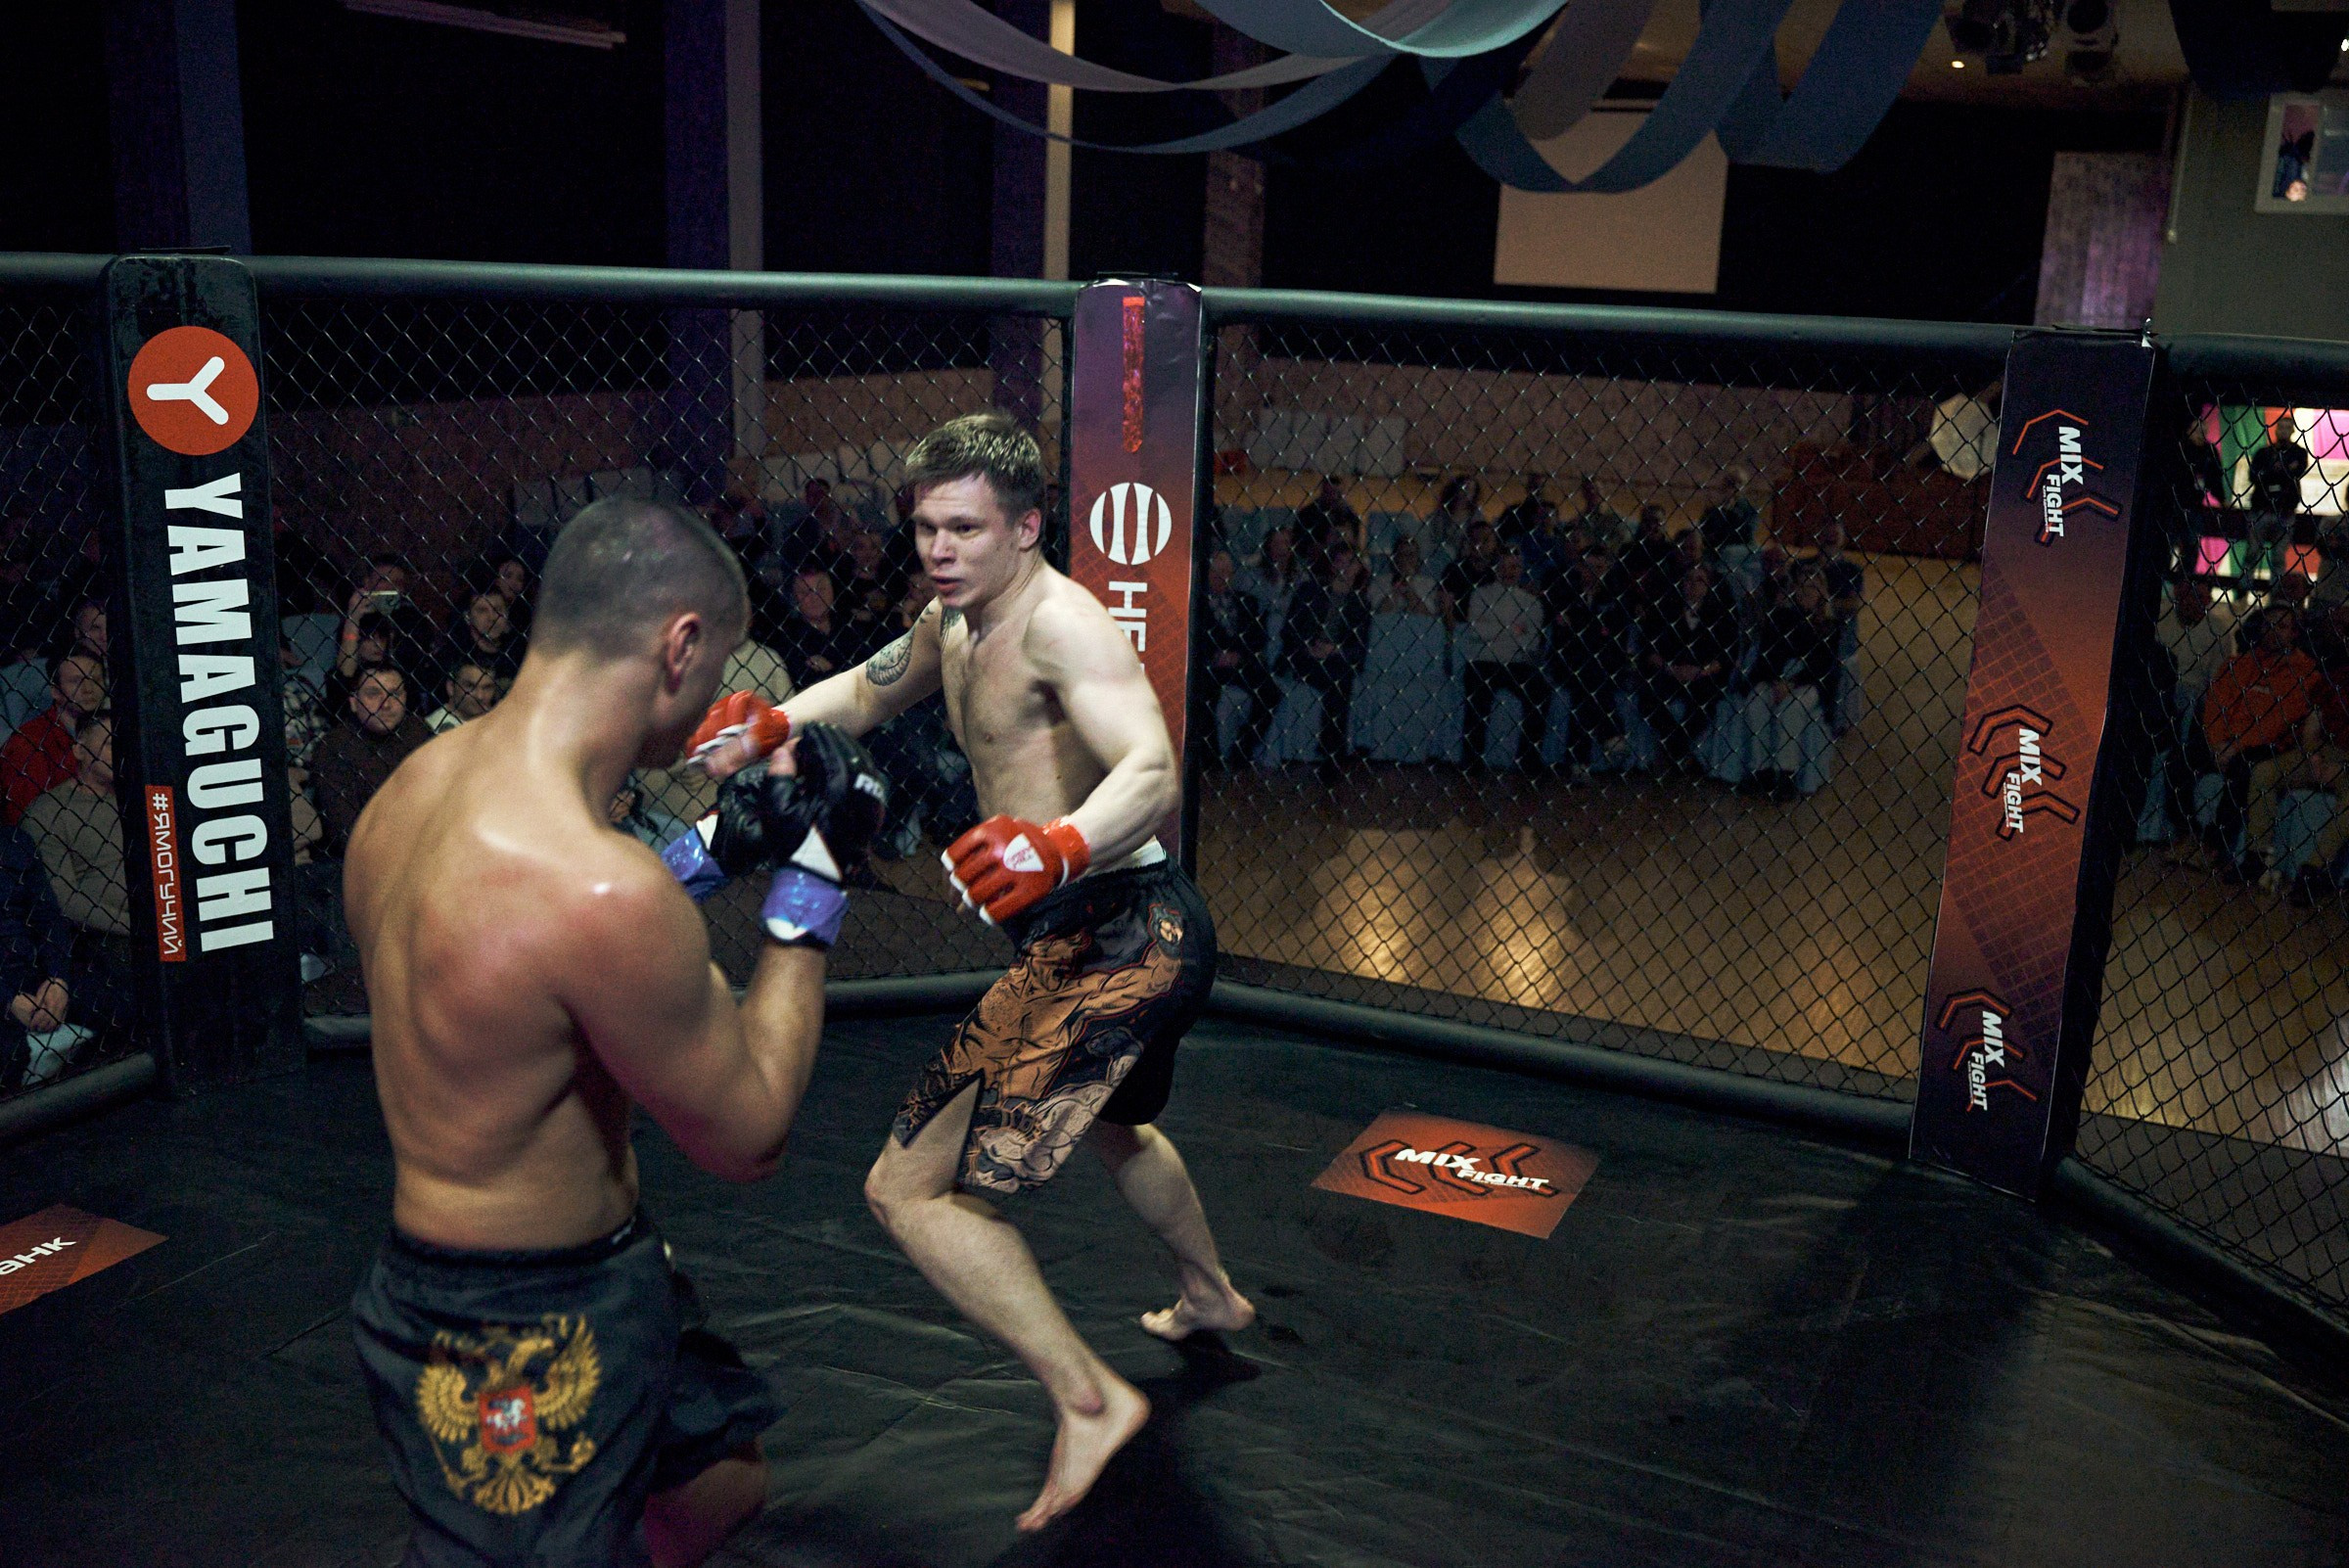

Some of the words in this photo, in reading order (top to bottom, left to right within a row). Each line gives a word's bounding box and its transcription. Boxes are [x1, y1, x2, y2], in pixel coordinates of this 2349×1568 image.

[147, 355, 230, 426] Y
[2058, 426, 2084, 485] MIX
[2046, 474, 2064, 537] FIGHT
[164, 472, 274, 952] YAMAGUCHI
[2018, 728, 2043, 786] MIX
[2006, 771, 2024, 834] FIGHT
[152, 793, 183, 955] #ЯМОГУЧИЙ
[1982, 1010, 2005, 1069] MIX
[1970, 1050, 1988, 1112] FIGHT
[1395, 1148, 1482, 1171] MIX
[1456, 1169, 1549, 1189] FIGHT
